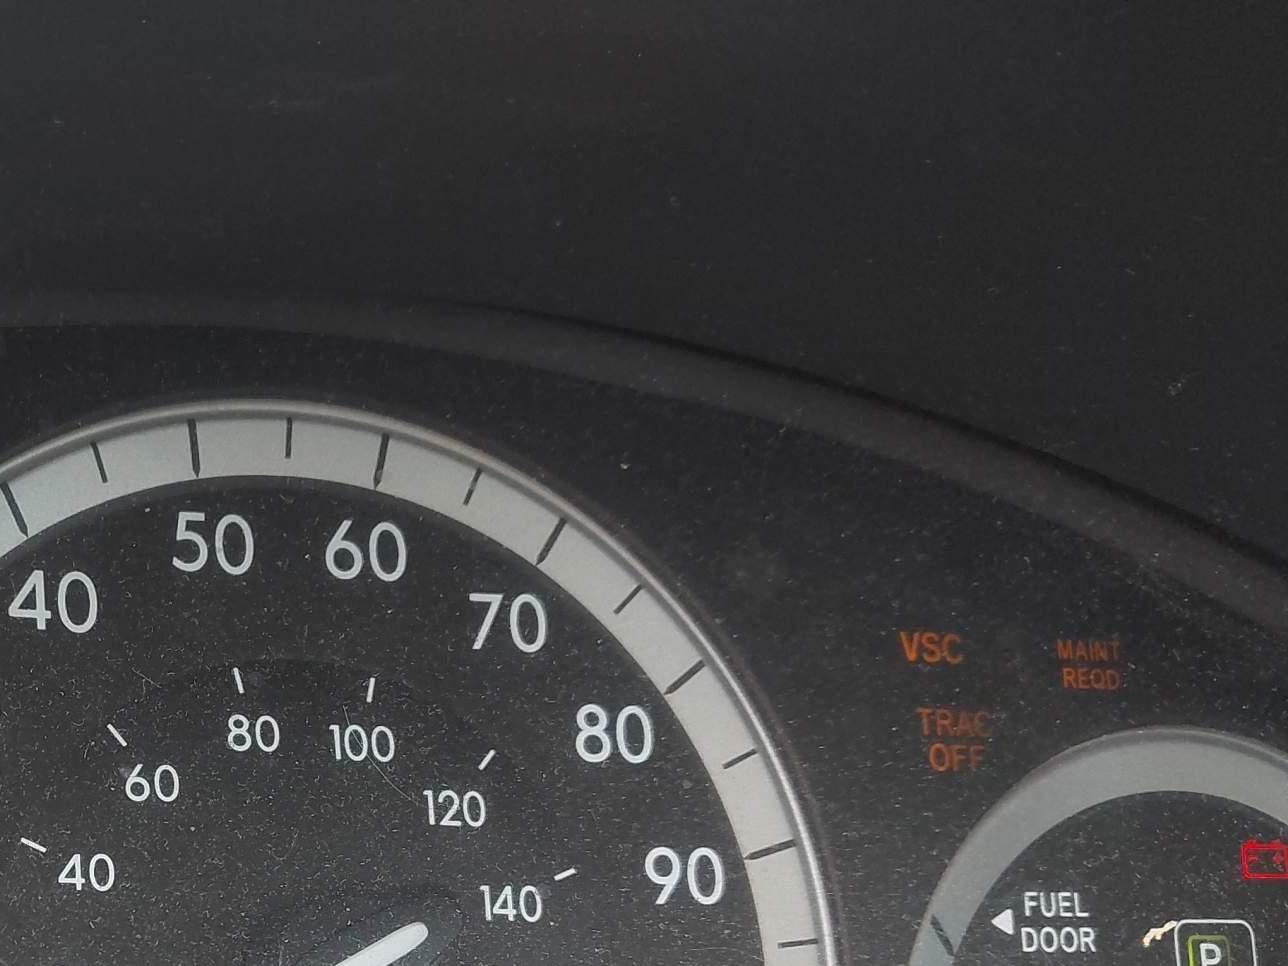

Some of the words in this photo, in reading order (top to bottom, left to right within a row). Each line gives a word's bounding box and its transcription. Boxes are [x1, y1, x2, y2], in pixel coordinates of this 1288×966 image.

[172, 512, 255, 575] 50
[325, 520, 407, 582] 60
[8, 570, 98, 633] 40
[469, 592, 547, 653] 70
[899, 631, 964, 665] VSC
[1057, 638, 1121, 661] MAINT
[1063, 667, 1121, 690] REQD
[227, 715, 280, 753] 80
[575, 704, 653, 763] 80
[916, 706, 993, 737] TRAC
[329, 724, 395, 763] 100
[928, 743, 985, 772] OFF
[125, 764, 179, 802] 60
[423, 789, 486, 827] 120
[58, 853, 115, 892] 40
[644, 847, 724, 905] 90
[479, 885, 542, 923] 140
[1023, 891, 1090, 918] FUEL
[1021, 926, 1096, 954] DOOR
